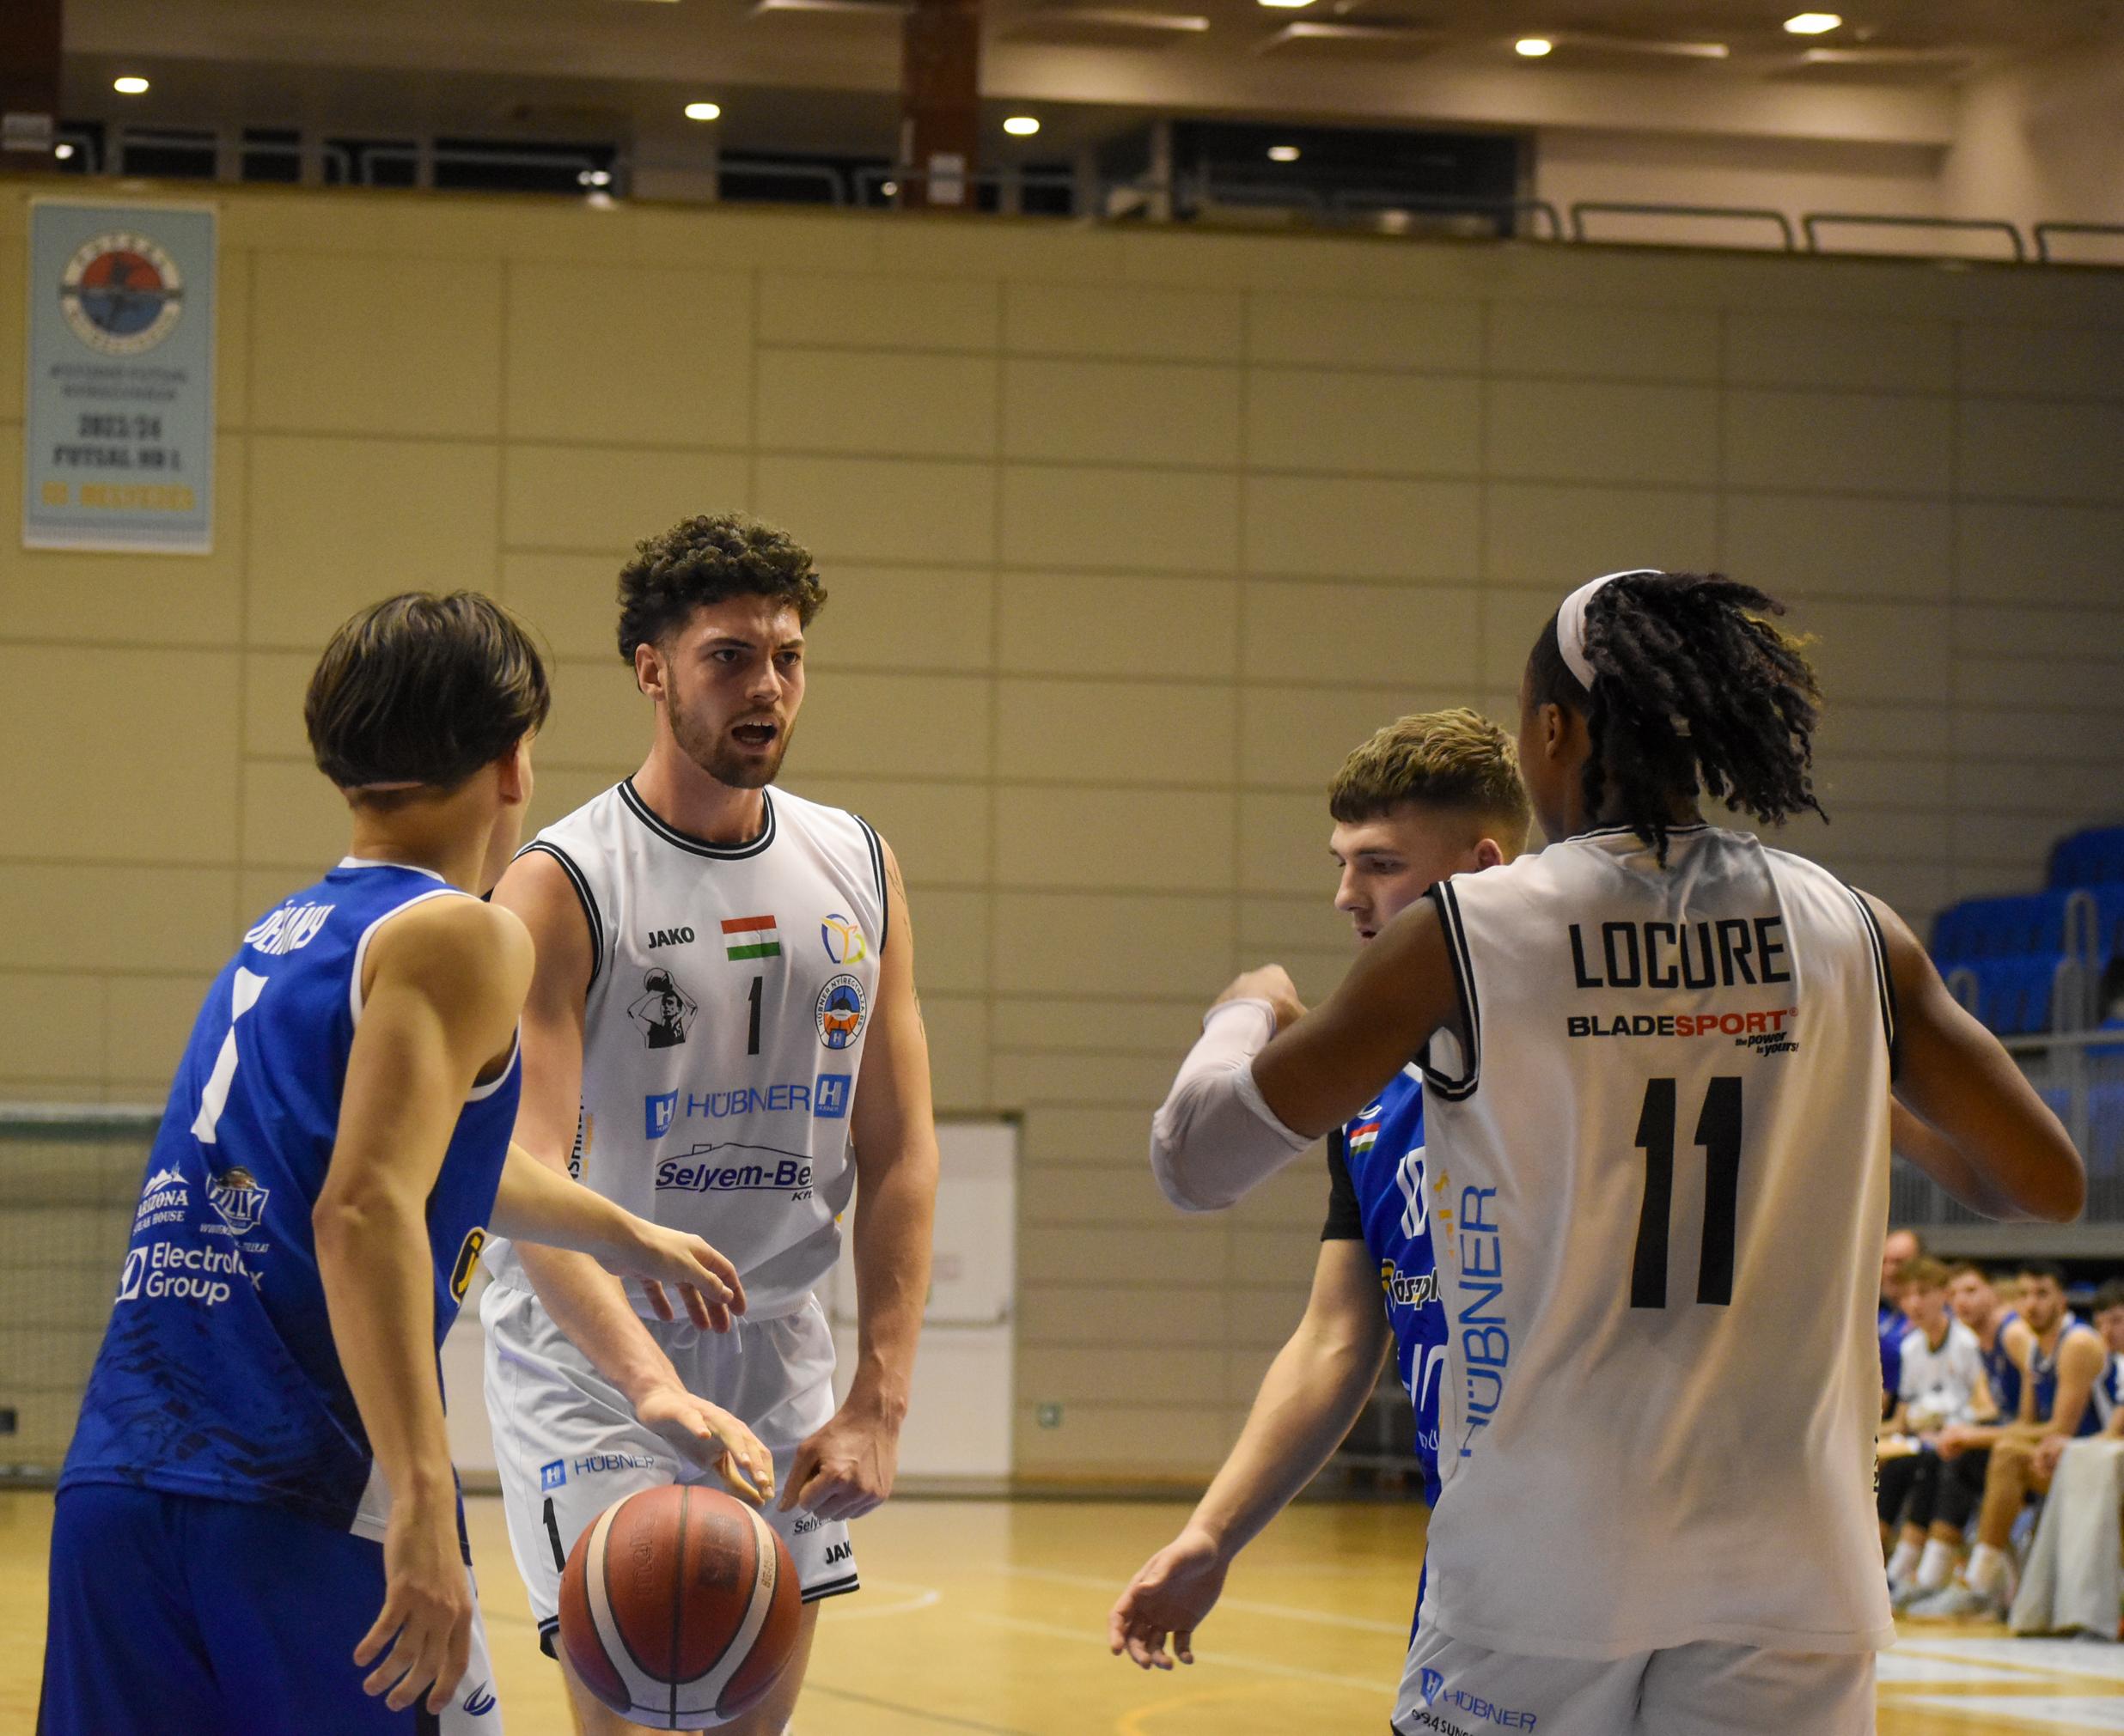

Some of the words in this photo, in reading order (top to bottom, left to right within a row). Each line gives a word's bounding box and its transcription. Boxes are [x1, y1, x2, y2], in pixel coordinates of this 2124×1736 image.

[648, 927, 695, 949] JAKO
[1568, 916, 1791, 990] LOCURE
[748, 976, 763, 1055] 1
[1748, 1032, 1787, 1048] power
[687, 1084, 811, 1118] HÜBNER
[656, 1160, 813, 1192] Selyem-Be
[1630, 1076, 1743, 1309] 11
[137, 1190, 189, 1218] ARIZONA
[152, 1210, 186, 1225] HOUSE
[146, 1270, 230, 1306] Group
[1458, 1185, 1510, 1458] HÜBNER
[574, 1453, 655, 1476] HÜBNER
[543, 1496, 566, 1574] 1
[1443, 1690, 1537, 1734] HÜBNER
